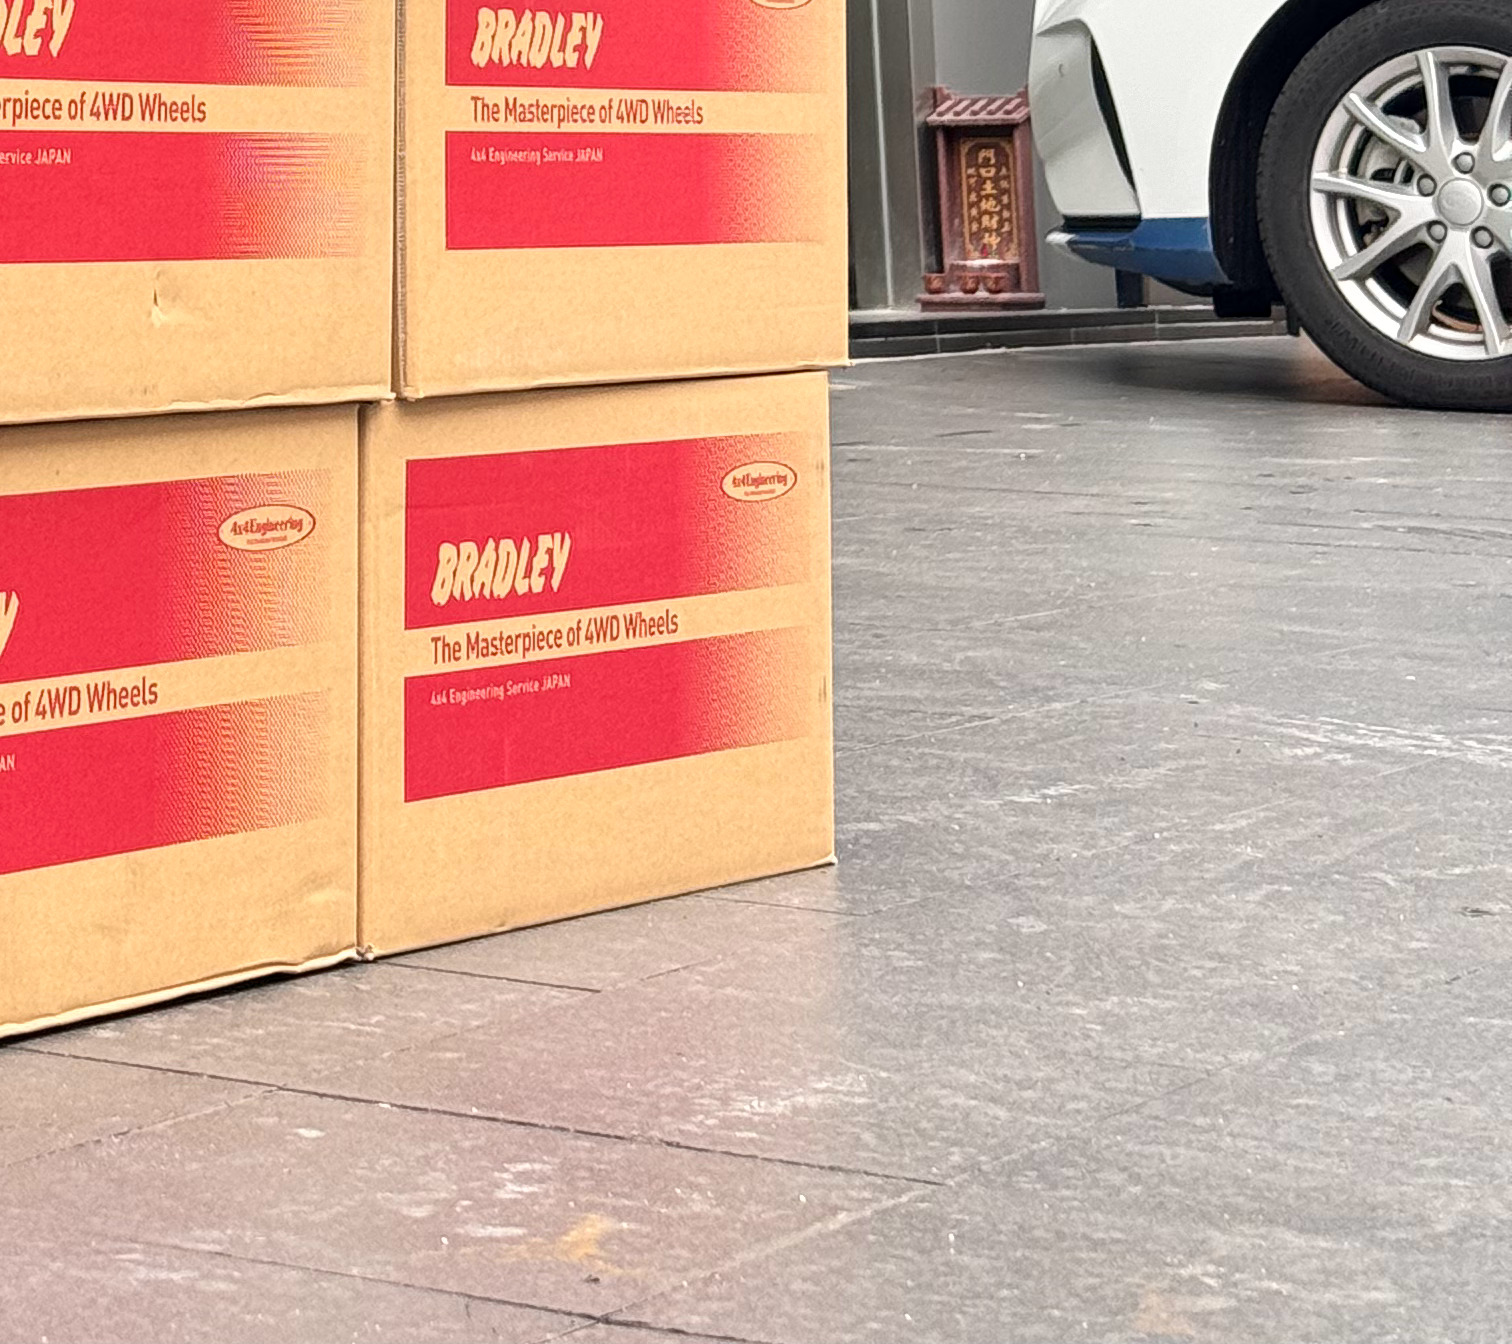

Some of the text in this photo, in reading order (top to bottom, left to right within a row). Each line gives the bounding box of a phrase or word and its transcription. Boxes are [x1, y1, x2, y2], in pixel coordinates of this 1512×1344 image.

[471, 7, 603, 70] BRADLEY
[68, 91, 86, 121] of
[89, 91, 133, 121] 4WD
[139, 93, 206, 123] Wheels
[471, 96, 703, 129] The Masterpiece of 4WD Wheels
[35, 149, 71, 164] JAPAN
[431, 532, 571, 606] BRADLEY
[431, 609, 678, 664] The Masterpiece of 4WD Wheels
[11, 692, 31, 723] of
[35, 685, 81, 720] 4WD
[86, 677, 158, 713] Wheels
[450, 683, 504, 705] Engineering
[541, 673, 571, 690] JAPAN
